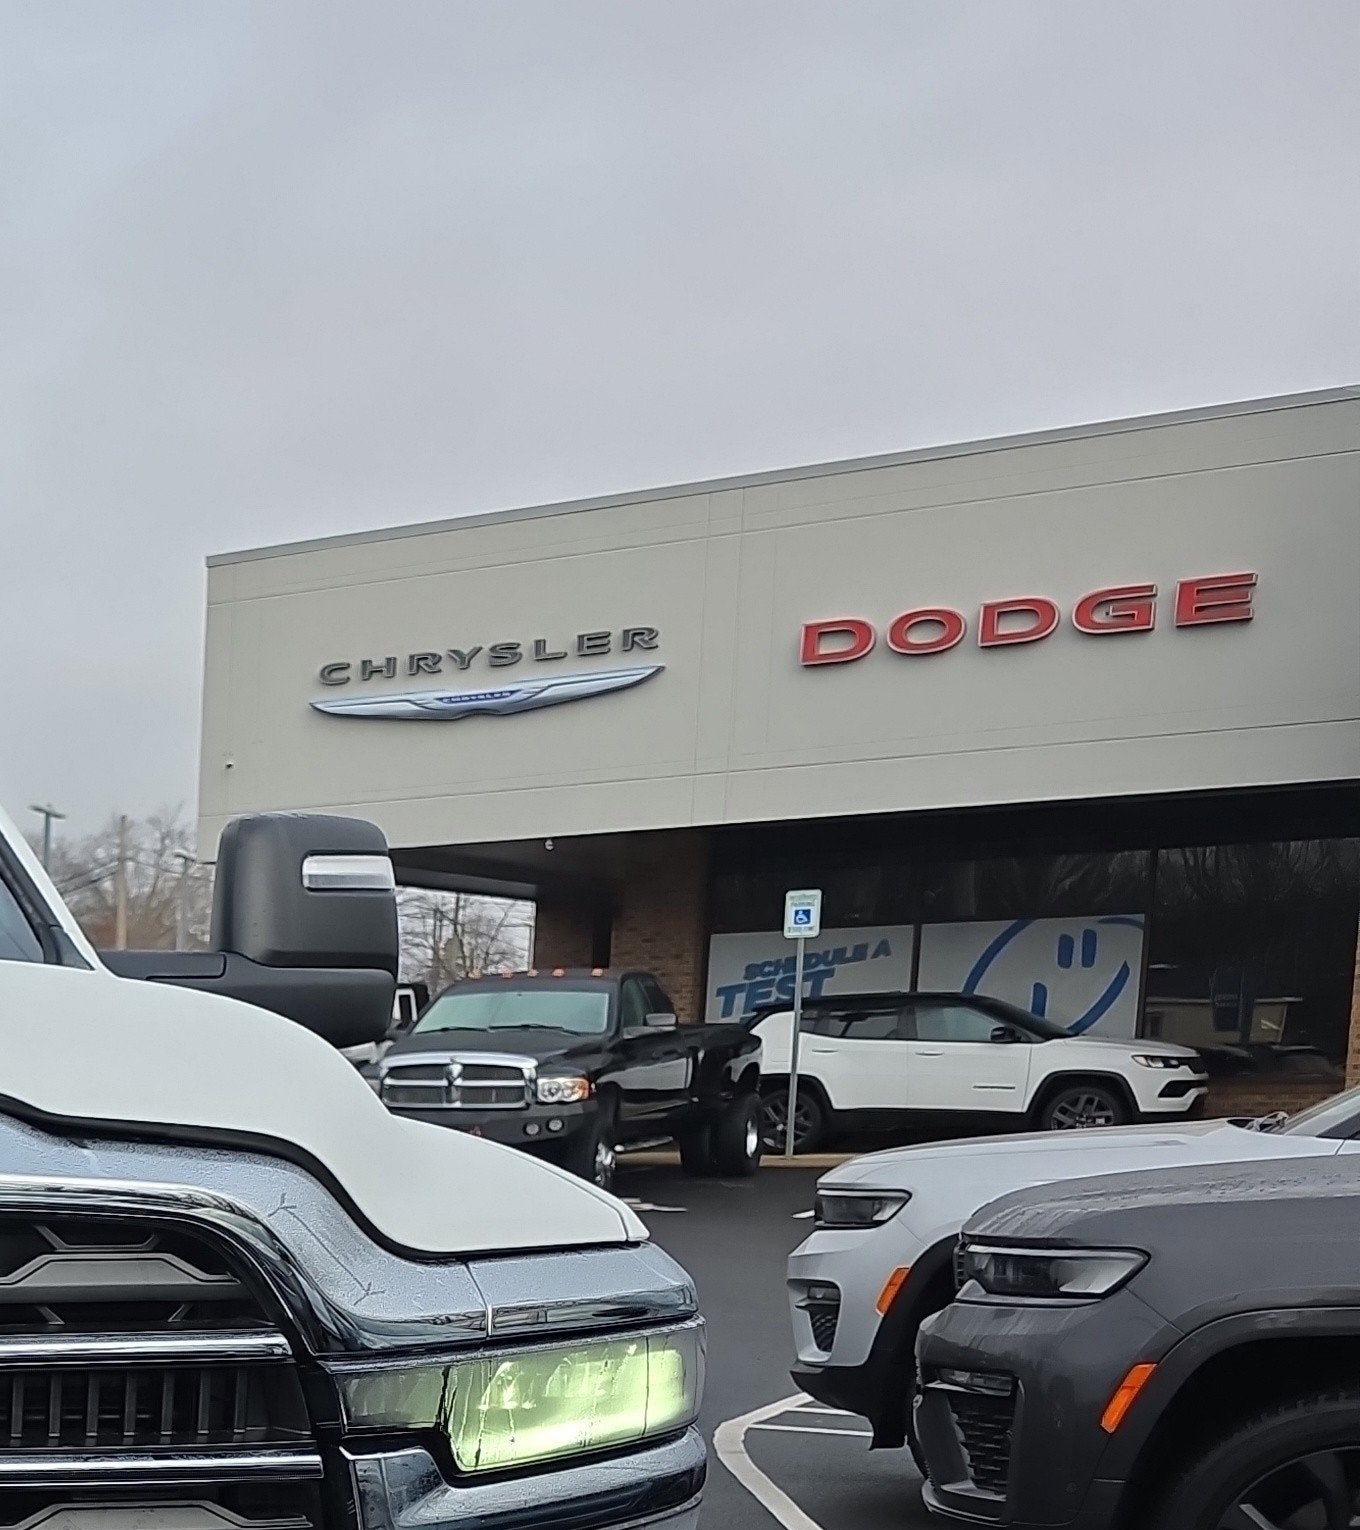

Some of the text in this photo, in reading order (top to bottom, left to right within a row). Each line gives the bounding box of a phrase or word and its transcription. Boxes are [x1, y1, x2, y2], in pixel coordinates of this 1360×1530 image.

[799, 572, 1259, 667] DODGE
[319, 626, 660, 685] CHRYSLER
[870, 938, 892, 959] A
[715, 967, 836, 1019] TEST
